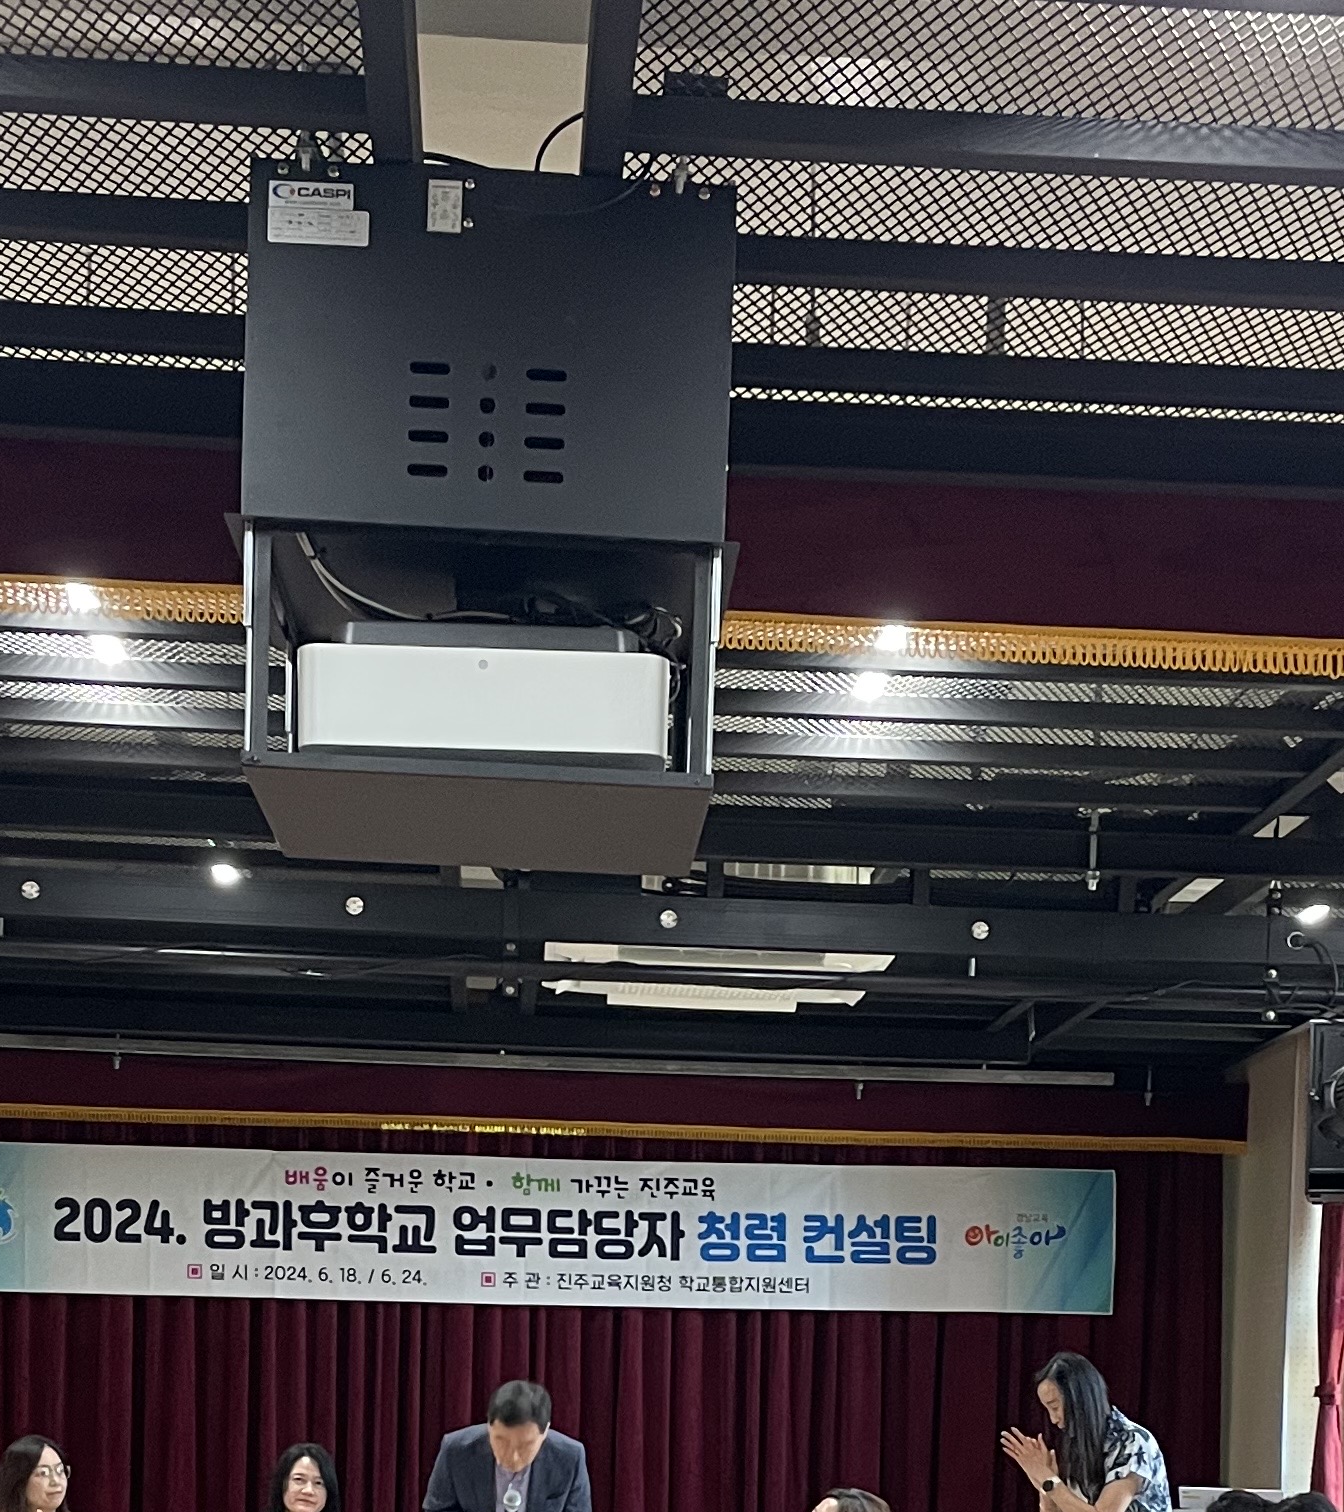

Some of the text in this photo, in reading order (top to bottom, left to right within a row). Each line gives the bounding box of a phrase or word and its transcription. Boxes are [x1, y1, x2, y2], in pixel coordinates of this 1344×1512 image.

[284, 1166, 353, 1191] 배움이
[364, 1167, 424, 1194] 즐거운
[432, 1169, 476, 1193] 학교
[511, 1172, 561, 1195] 함께
[570, 1176, 629, 1199] 가꾸는
[639, 1177, 716, 1201] 진주교육
[53, 1197, 938, 1266] 2024. 방과후학교 업무담당자 청렴 컨설팅
[264, 1265, 313, 1284] 2024.
[556, 1272, 673, 1292] 진주교육지원청
[678, 1274, 811, 1294] 학교통합지원센터
